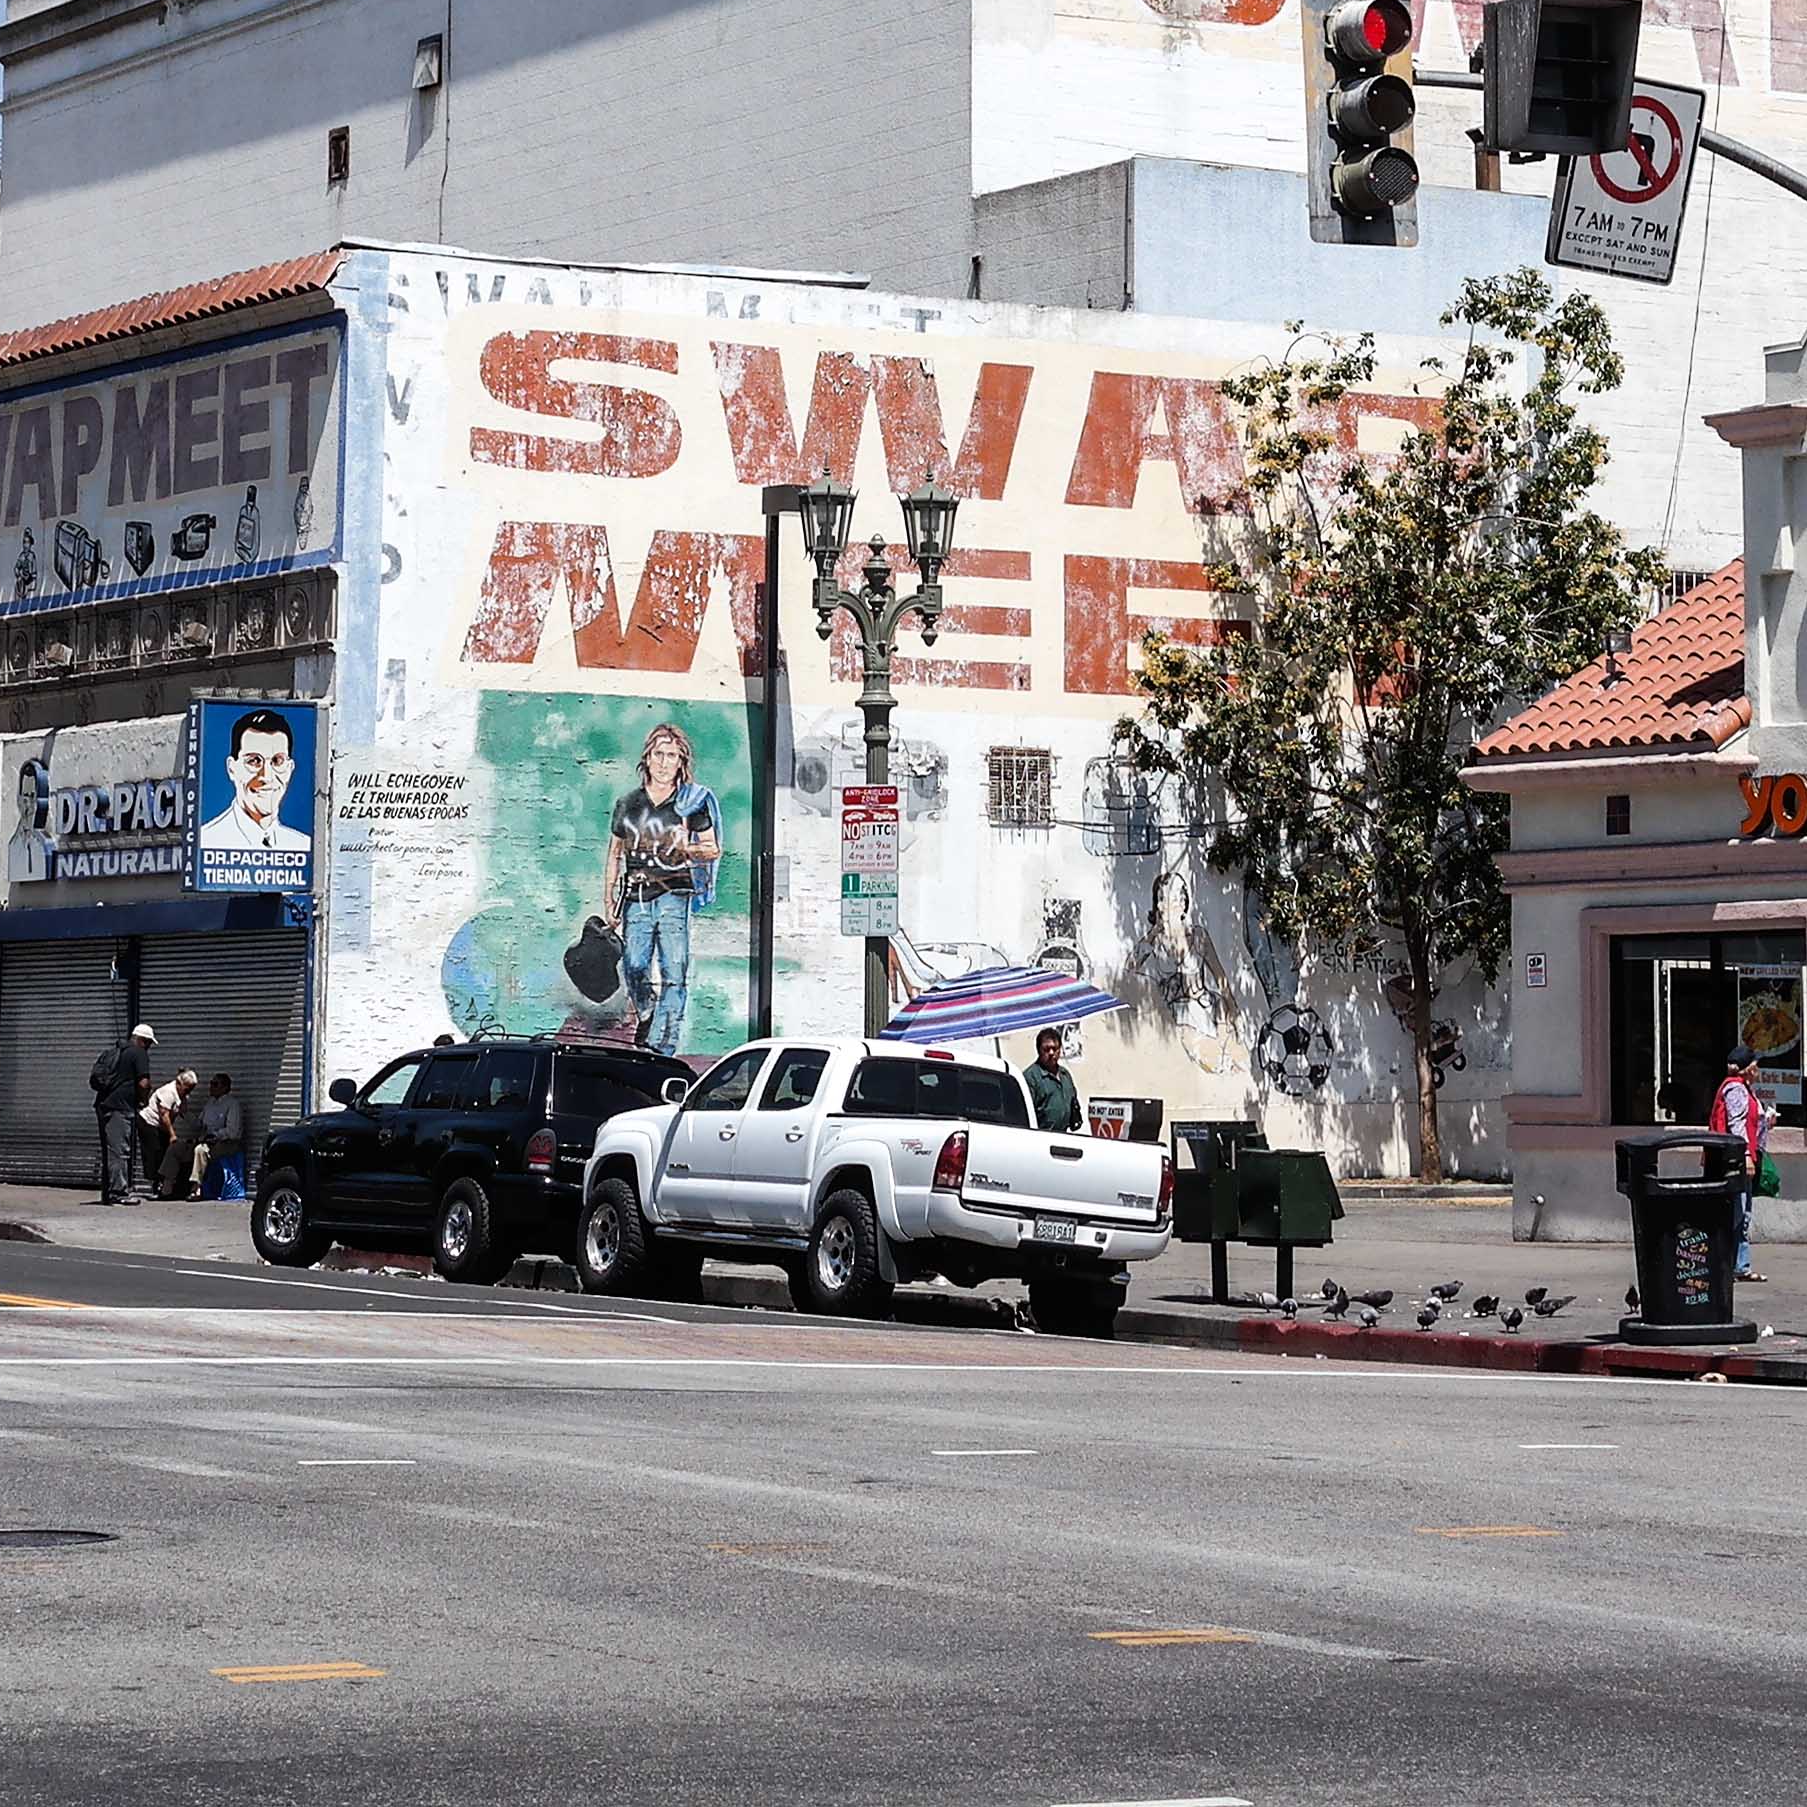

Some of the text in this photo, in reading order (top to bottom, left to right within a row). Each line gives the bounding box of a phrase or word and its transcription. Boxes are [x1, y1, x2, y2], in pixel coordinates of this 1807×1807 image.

[1565, 230, 1671, 258] EXCEPT SAT AND SUN
[1628, 256, 1656, 268] EXEMPT
[460, 520, 1426, 707] MEE
[348, 772, 465, 790] WILL ECHEGOYEN
[351, 791, 448, 805] EL TRIUNFADOR
[339, 806, 469, 820] DE LAS BUENAS EPOCAS
[843, 823, 860, 839] NO
[203, 851, 307, 867] DR.PACHECO
[203, 868, 306, 885] TIENDA OFICIAL
[861, 880, 896, 892] PARKING
[1679, 1232, 1709, 1248] trash
